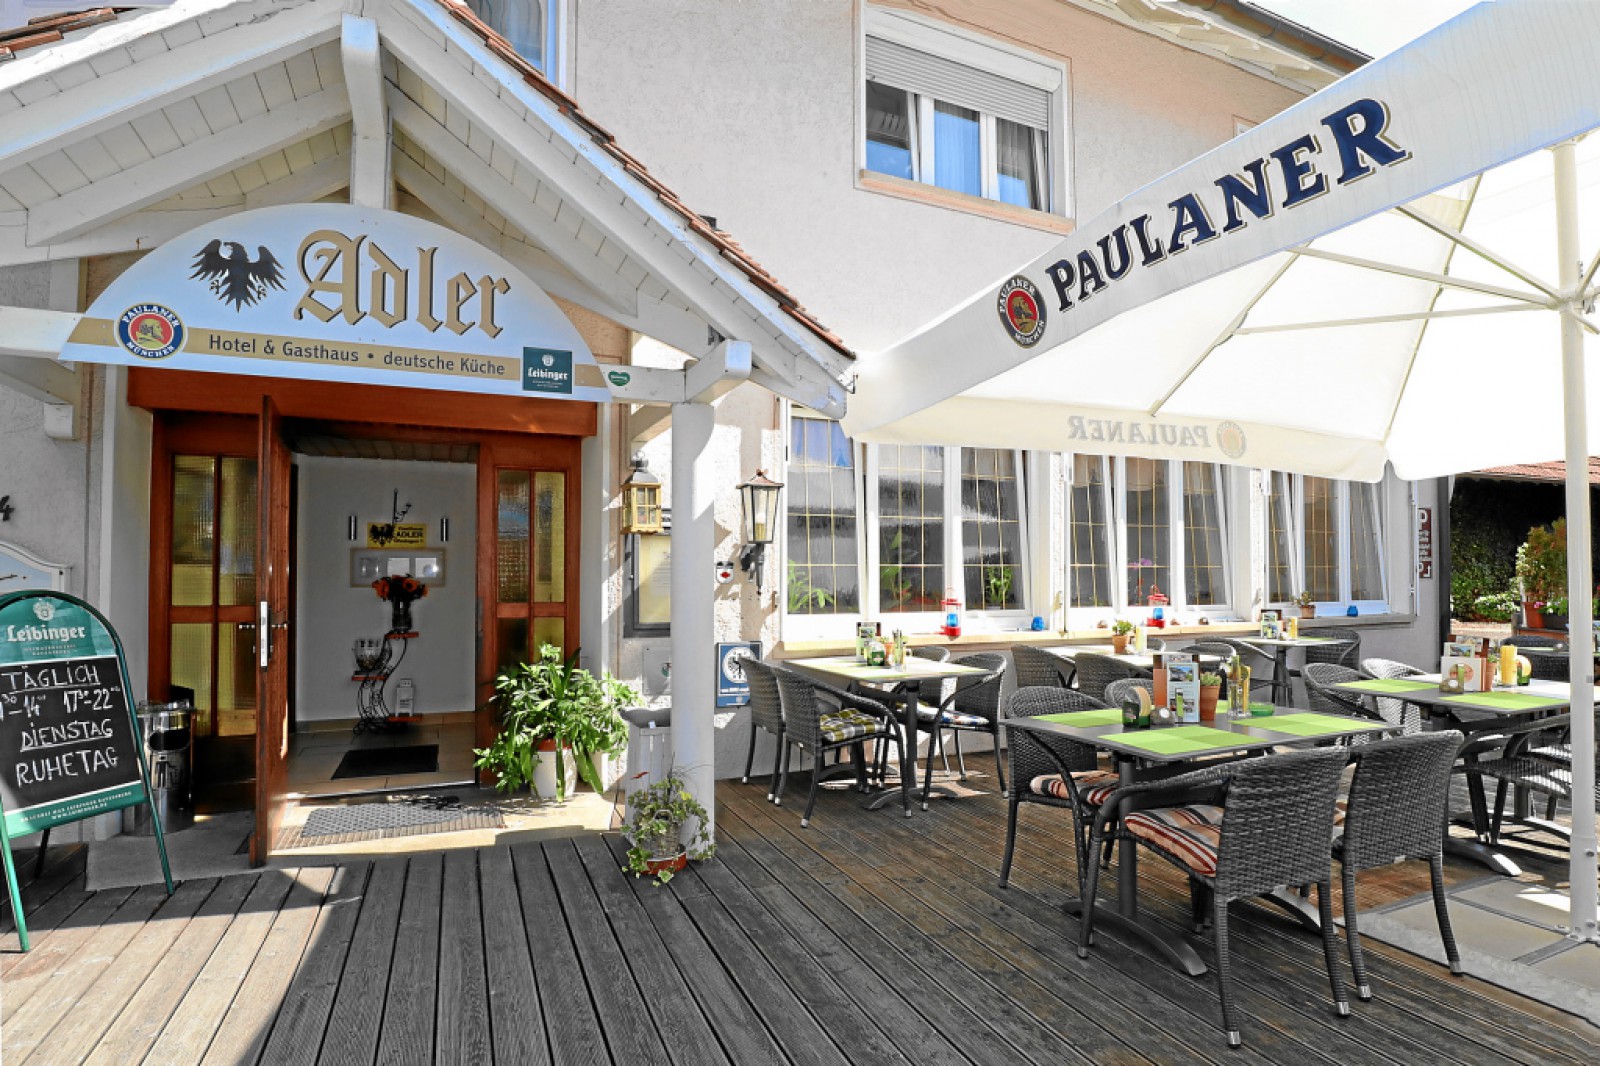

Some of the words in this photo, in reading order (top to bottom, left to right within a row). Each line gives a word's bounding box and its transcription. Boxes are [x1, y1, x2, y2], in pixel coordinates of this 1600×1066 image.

[1045, 98, 1414, 314] PAULANER
[293, 228, 511, 340] Adler
[999, 277, 1037, 314] PAULANER
[121, 304, 180, 328] PAULANER
[208, 333, 257, 354] Hotel
[263, 338, 276, 356] &
[282, 340, 360, 363] Gasthaus
[383, 350, 455, 371] deutsche
[459, 357, 506, 376] Küche
[527, 366, 569, 381] Leibinger
[6, 624, 87, 642] Leibinger
[0, 660, 101, 691] TÄGLICH
[20, 718, 114, 751] DIENSTAG
[15, 746, 119, 789] RUHETAG
